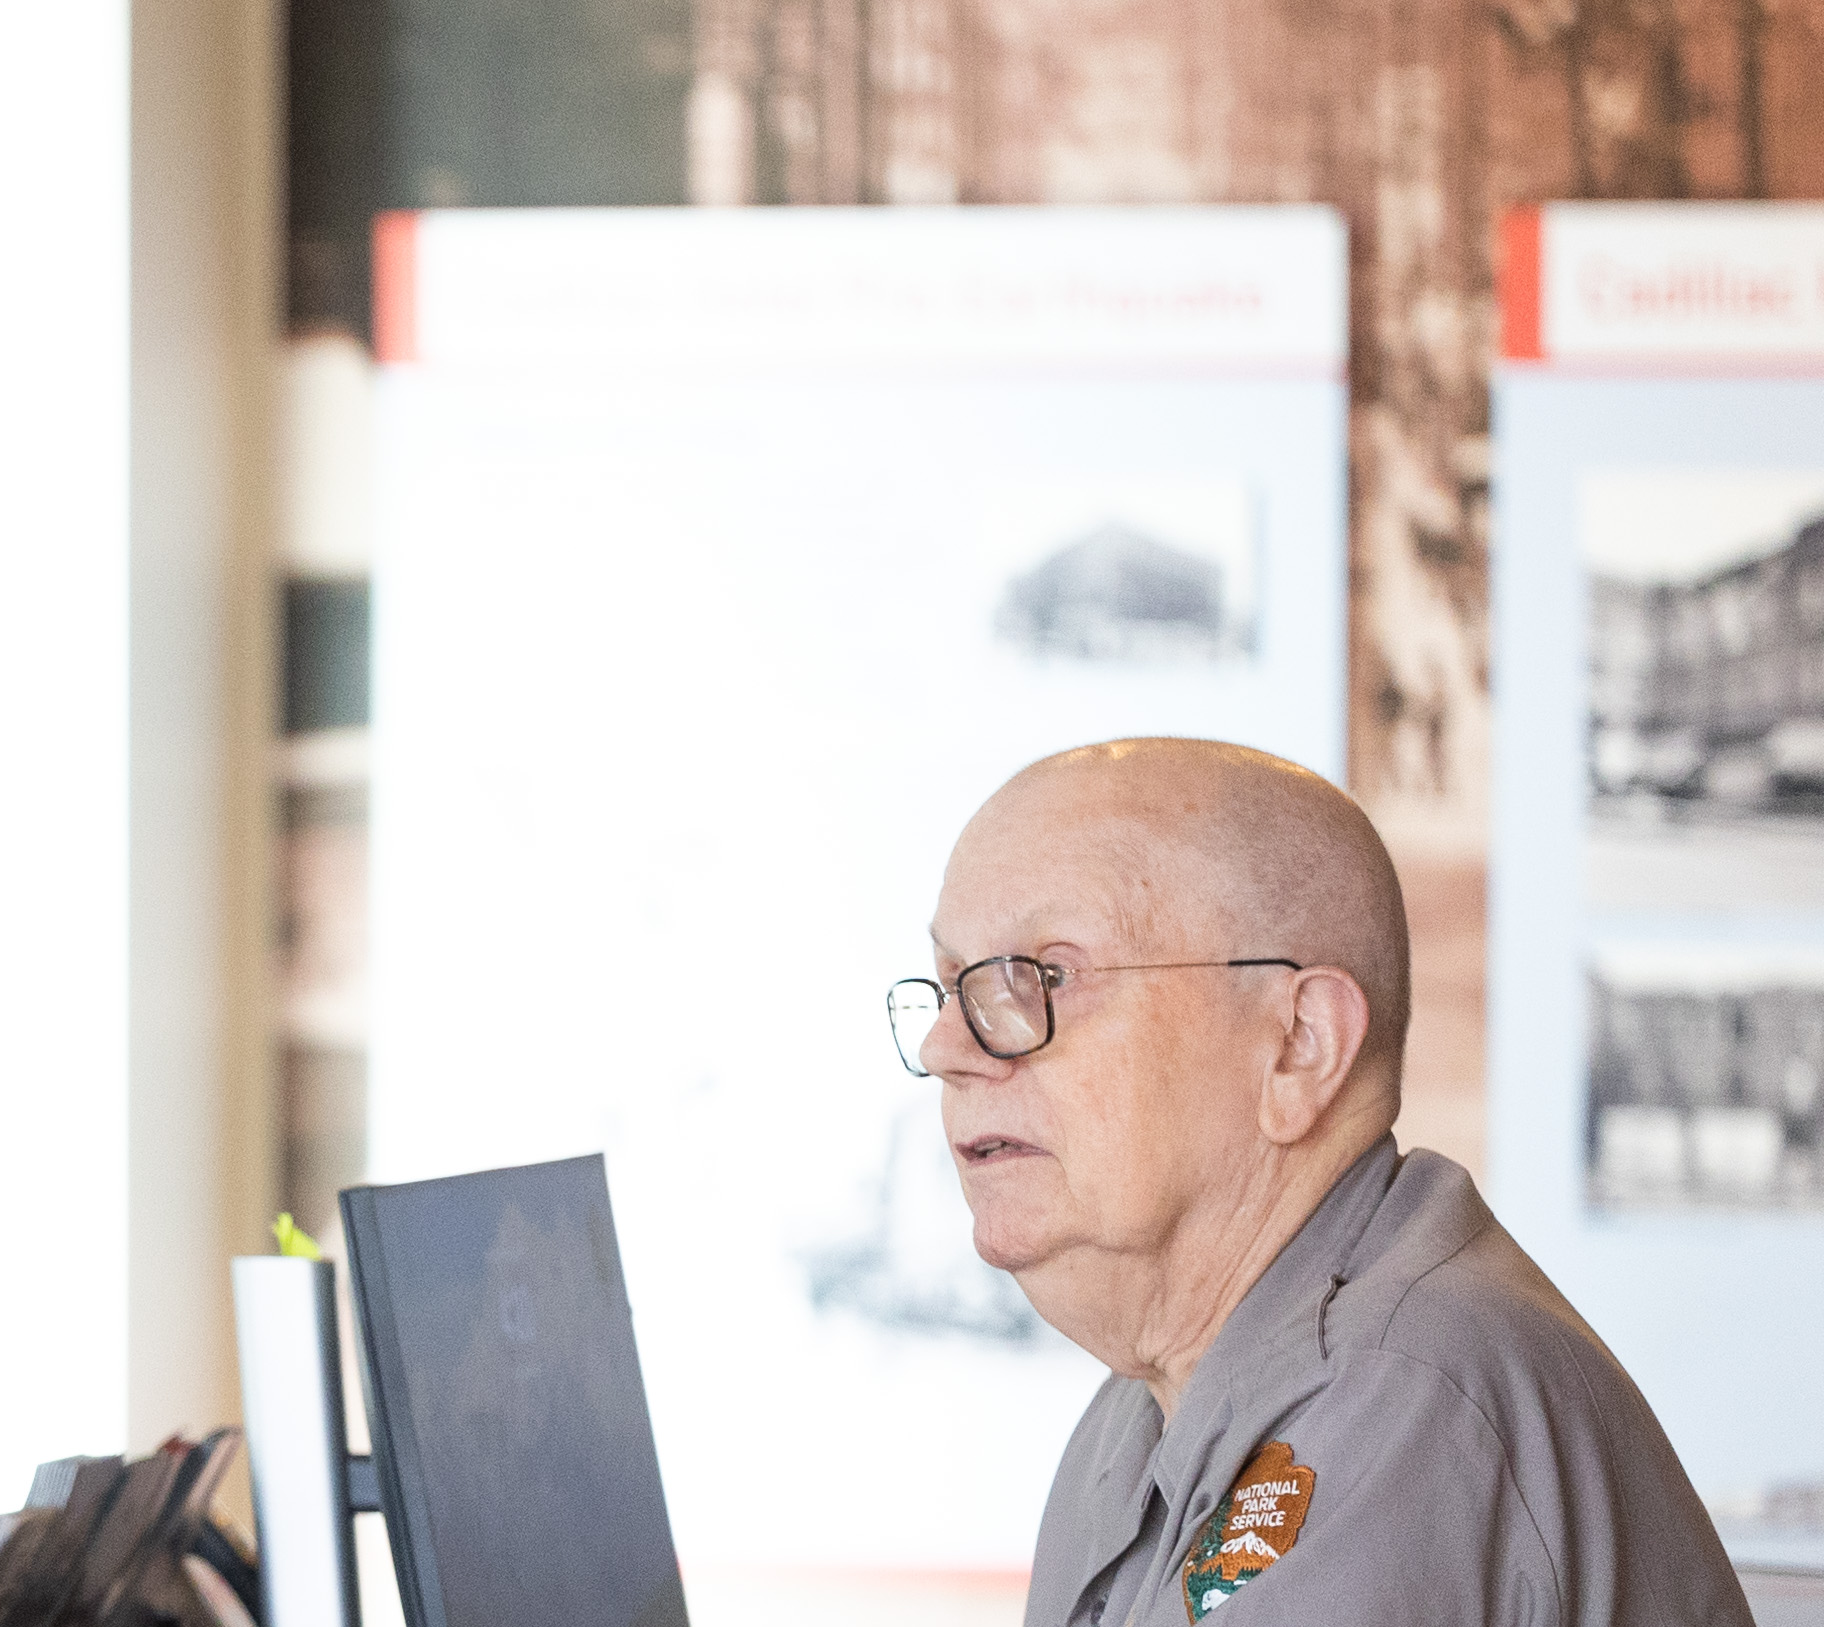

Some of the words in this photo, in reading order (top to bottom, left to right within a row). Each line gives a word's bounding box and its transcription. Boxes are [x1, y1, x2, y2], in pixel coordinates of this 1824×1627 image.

[1234, 1480, 1300, 1501] NATIONAL
[1241, 1497, 1278, 1513] PARK
[1229, 1510, 1286, 1531] SERVICE
